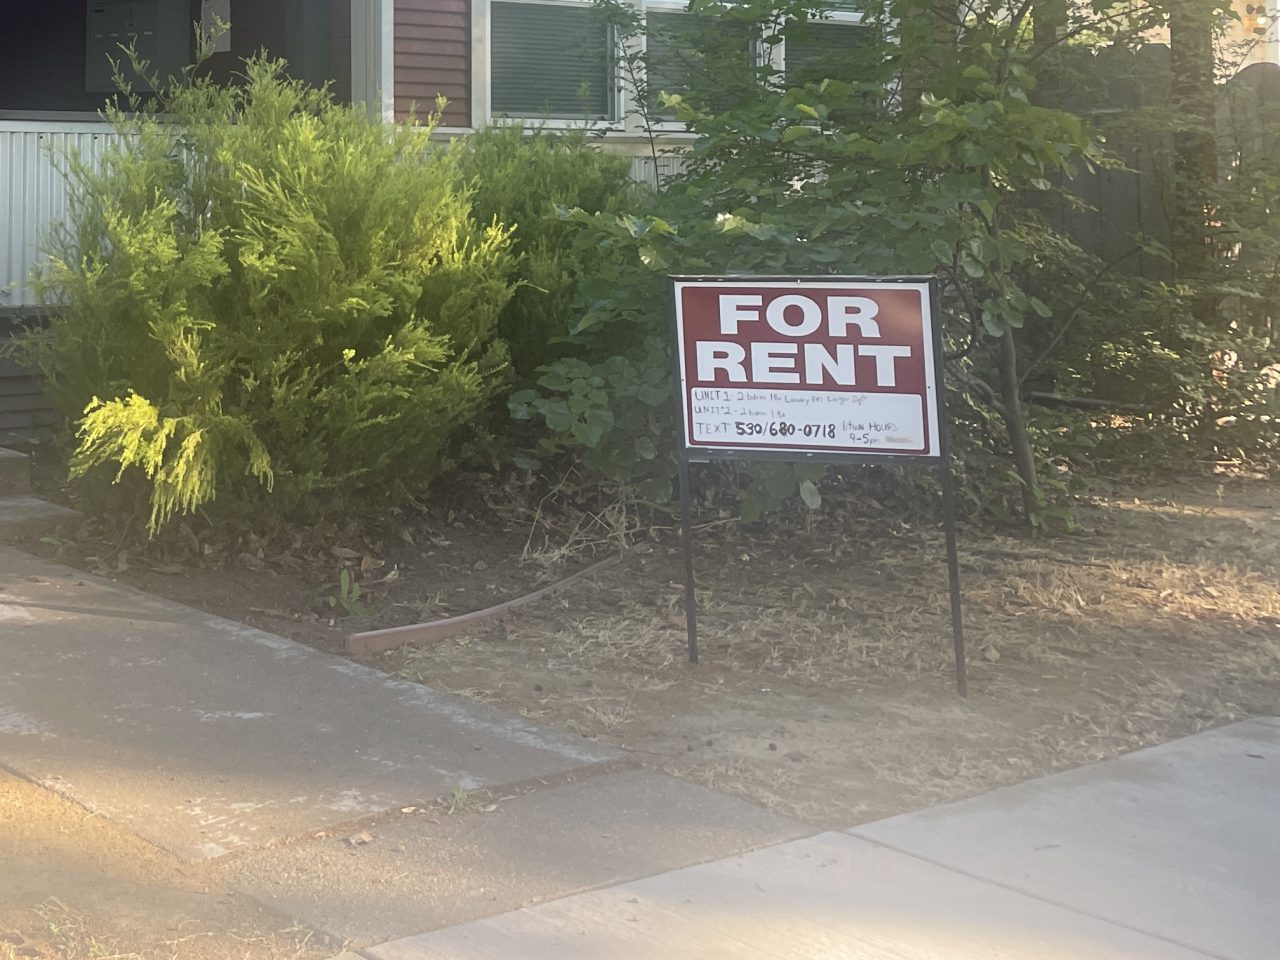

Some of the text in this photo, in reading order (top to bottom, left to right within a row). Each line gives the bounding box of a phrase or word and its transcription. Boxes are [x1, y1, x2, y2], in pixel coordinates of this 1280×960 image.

[718, 294, 881, 338] FOR
[695, 340, 912, 387] RENT
[694, 390, 720, 401] UNIT
[694, 405, 720, 415] UNIT
[695, 421, 731, 435] TEXT
